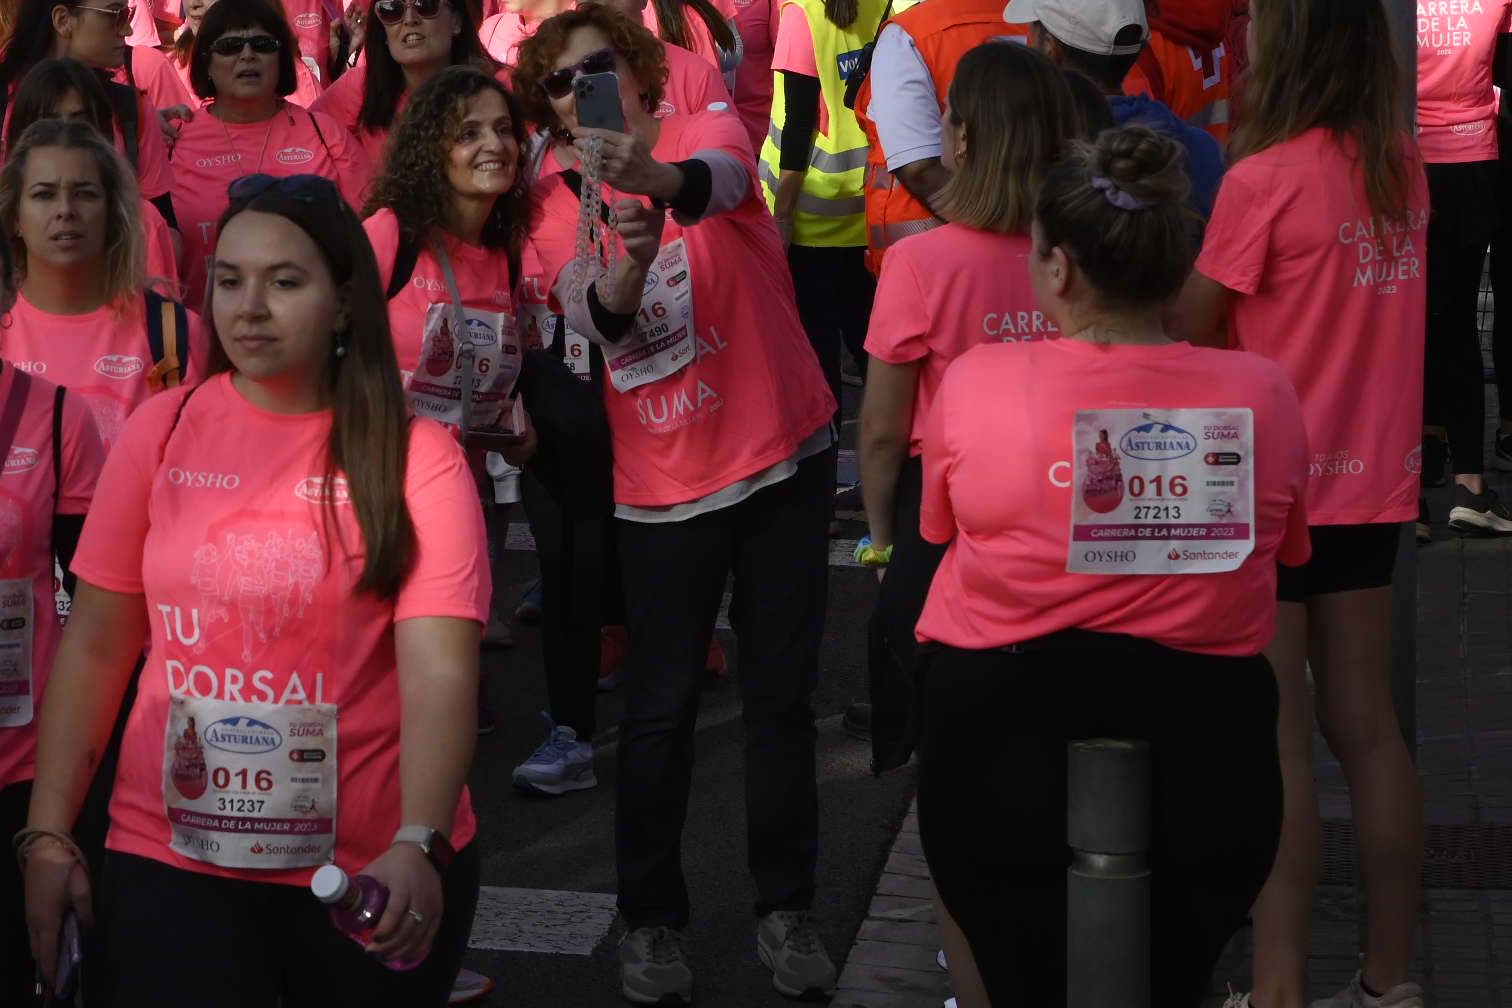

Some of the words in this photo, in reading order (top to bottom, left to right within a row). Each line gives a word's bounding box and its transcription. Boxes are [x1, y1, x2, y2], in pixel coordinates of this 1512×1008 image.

[1418, 17, 1440, 32] DE
[1447, 16, 1468, 31] LA
[1417, 31, 1472, 49] MUJER
[196, 152, 242, 168] OYSHO
[1358, 241, 1384, 264] DE
[1393, 236, 1416, 258] LA
[659, 257, 683, 272] SUMA
[1353, 257, 1420, 287] MUJER
[639, 301, 668, 323] 16
[637, 380, 718, 424] SUMA
[1203, 432, 1239, 440] SUMA
[1126, 438, 1192, 452] ASTURIANA
[168, 467, 240, 490] OYSHO
[1128, 475, 1188, 497] 016
[1133, 506, 1181, 520] 27213
[1091, 528, 1136, 537] CARRERA
[1138, 528, 1153, 537] DE
[1155, 528, 1169, 537] LA
[1171, 527, 1207, 537] MUJER
[1210, 527, 1235, 536] 2023
[1084, 549, 1136, 563] OYSHO
[1182, 548, 1240, 561] Santander
[158, 603, 199, 646] TU
[209, 729, 276, 747] ASTURIANA
[289, 727, 324, 737] SUMA
[212, 766, 274, 792] 016
[218, 797, 265, 813] 31237
[180, 813, 219, 828] CARRERA
[221, 820, 236, 829] DE
[237, 821, 252, 830] LA
[253, 823, 289, 831] MUJER
[265, 842, 321, 856] Santander
